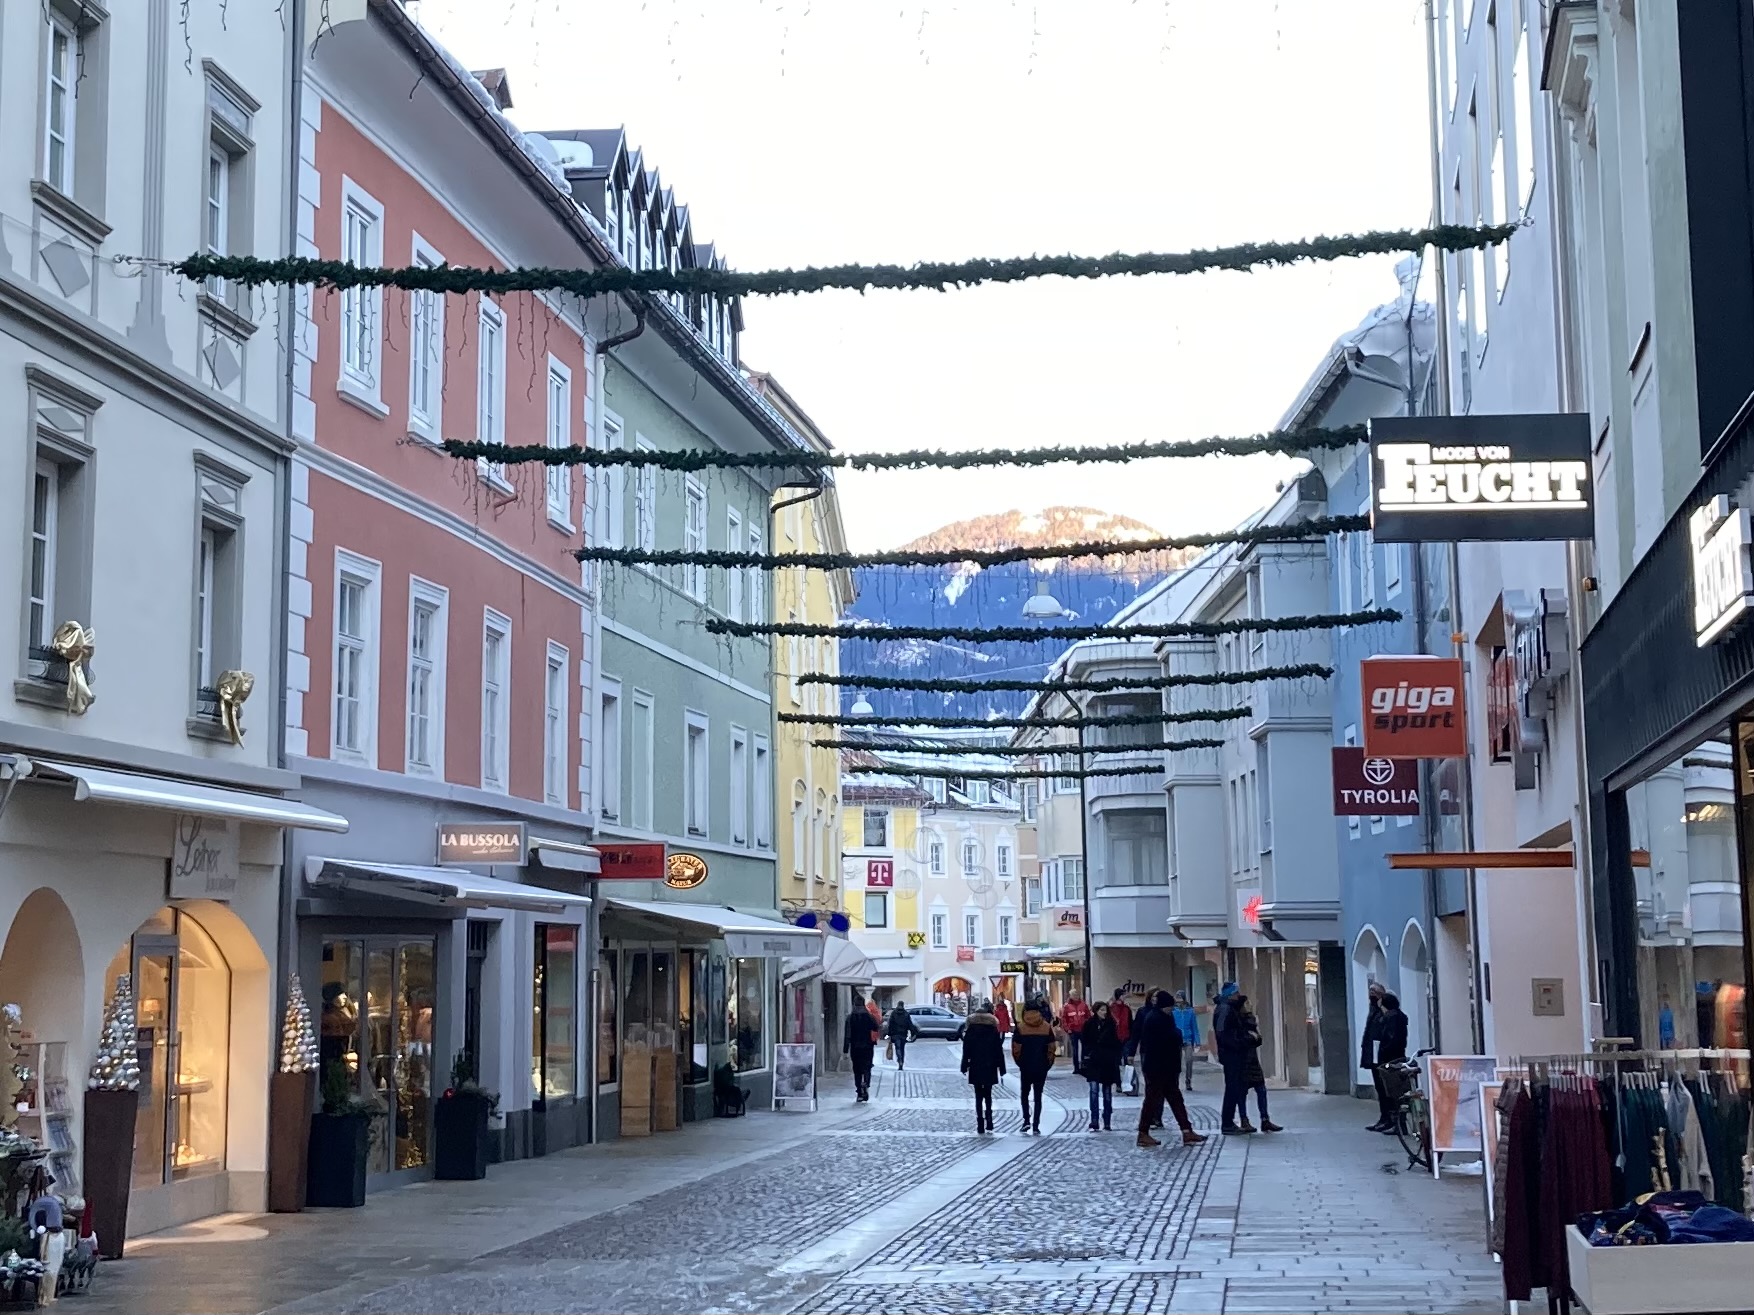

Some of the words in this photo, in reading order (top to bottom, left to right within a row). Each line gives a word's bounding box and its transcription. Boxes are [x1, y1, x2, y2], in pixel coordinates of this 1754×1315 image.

[1432, 447, 1475, 461] MODE
[1477, 446, 1510, 460] VON
[1377, 443, 1586, 503] FEUCHT
[1371, 681, 1455, 714] giga
[1374, 711, 1455, 734] sport
[1341, 789, 1420, 804] TYROLIA
[441, 833, 458, 846] LA
[460, 833, 520, 847] BUSSOLA
[871, 862, 889, 884] T
[1061, 910, 1079, 922] dm
